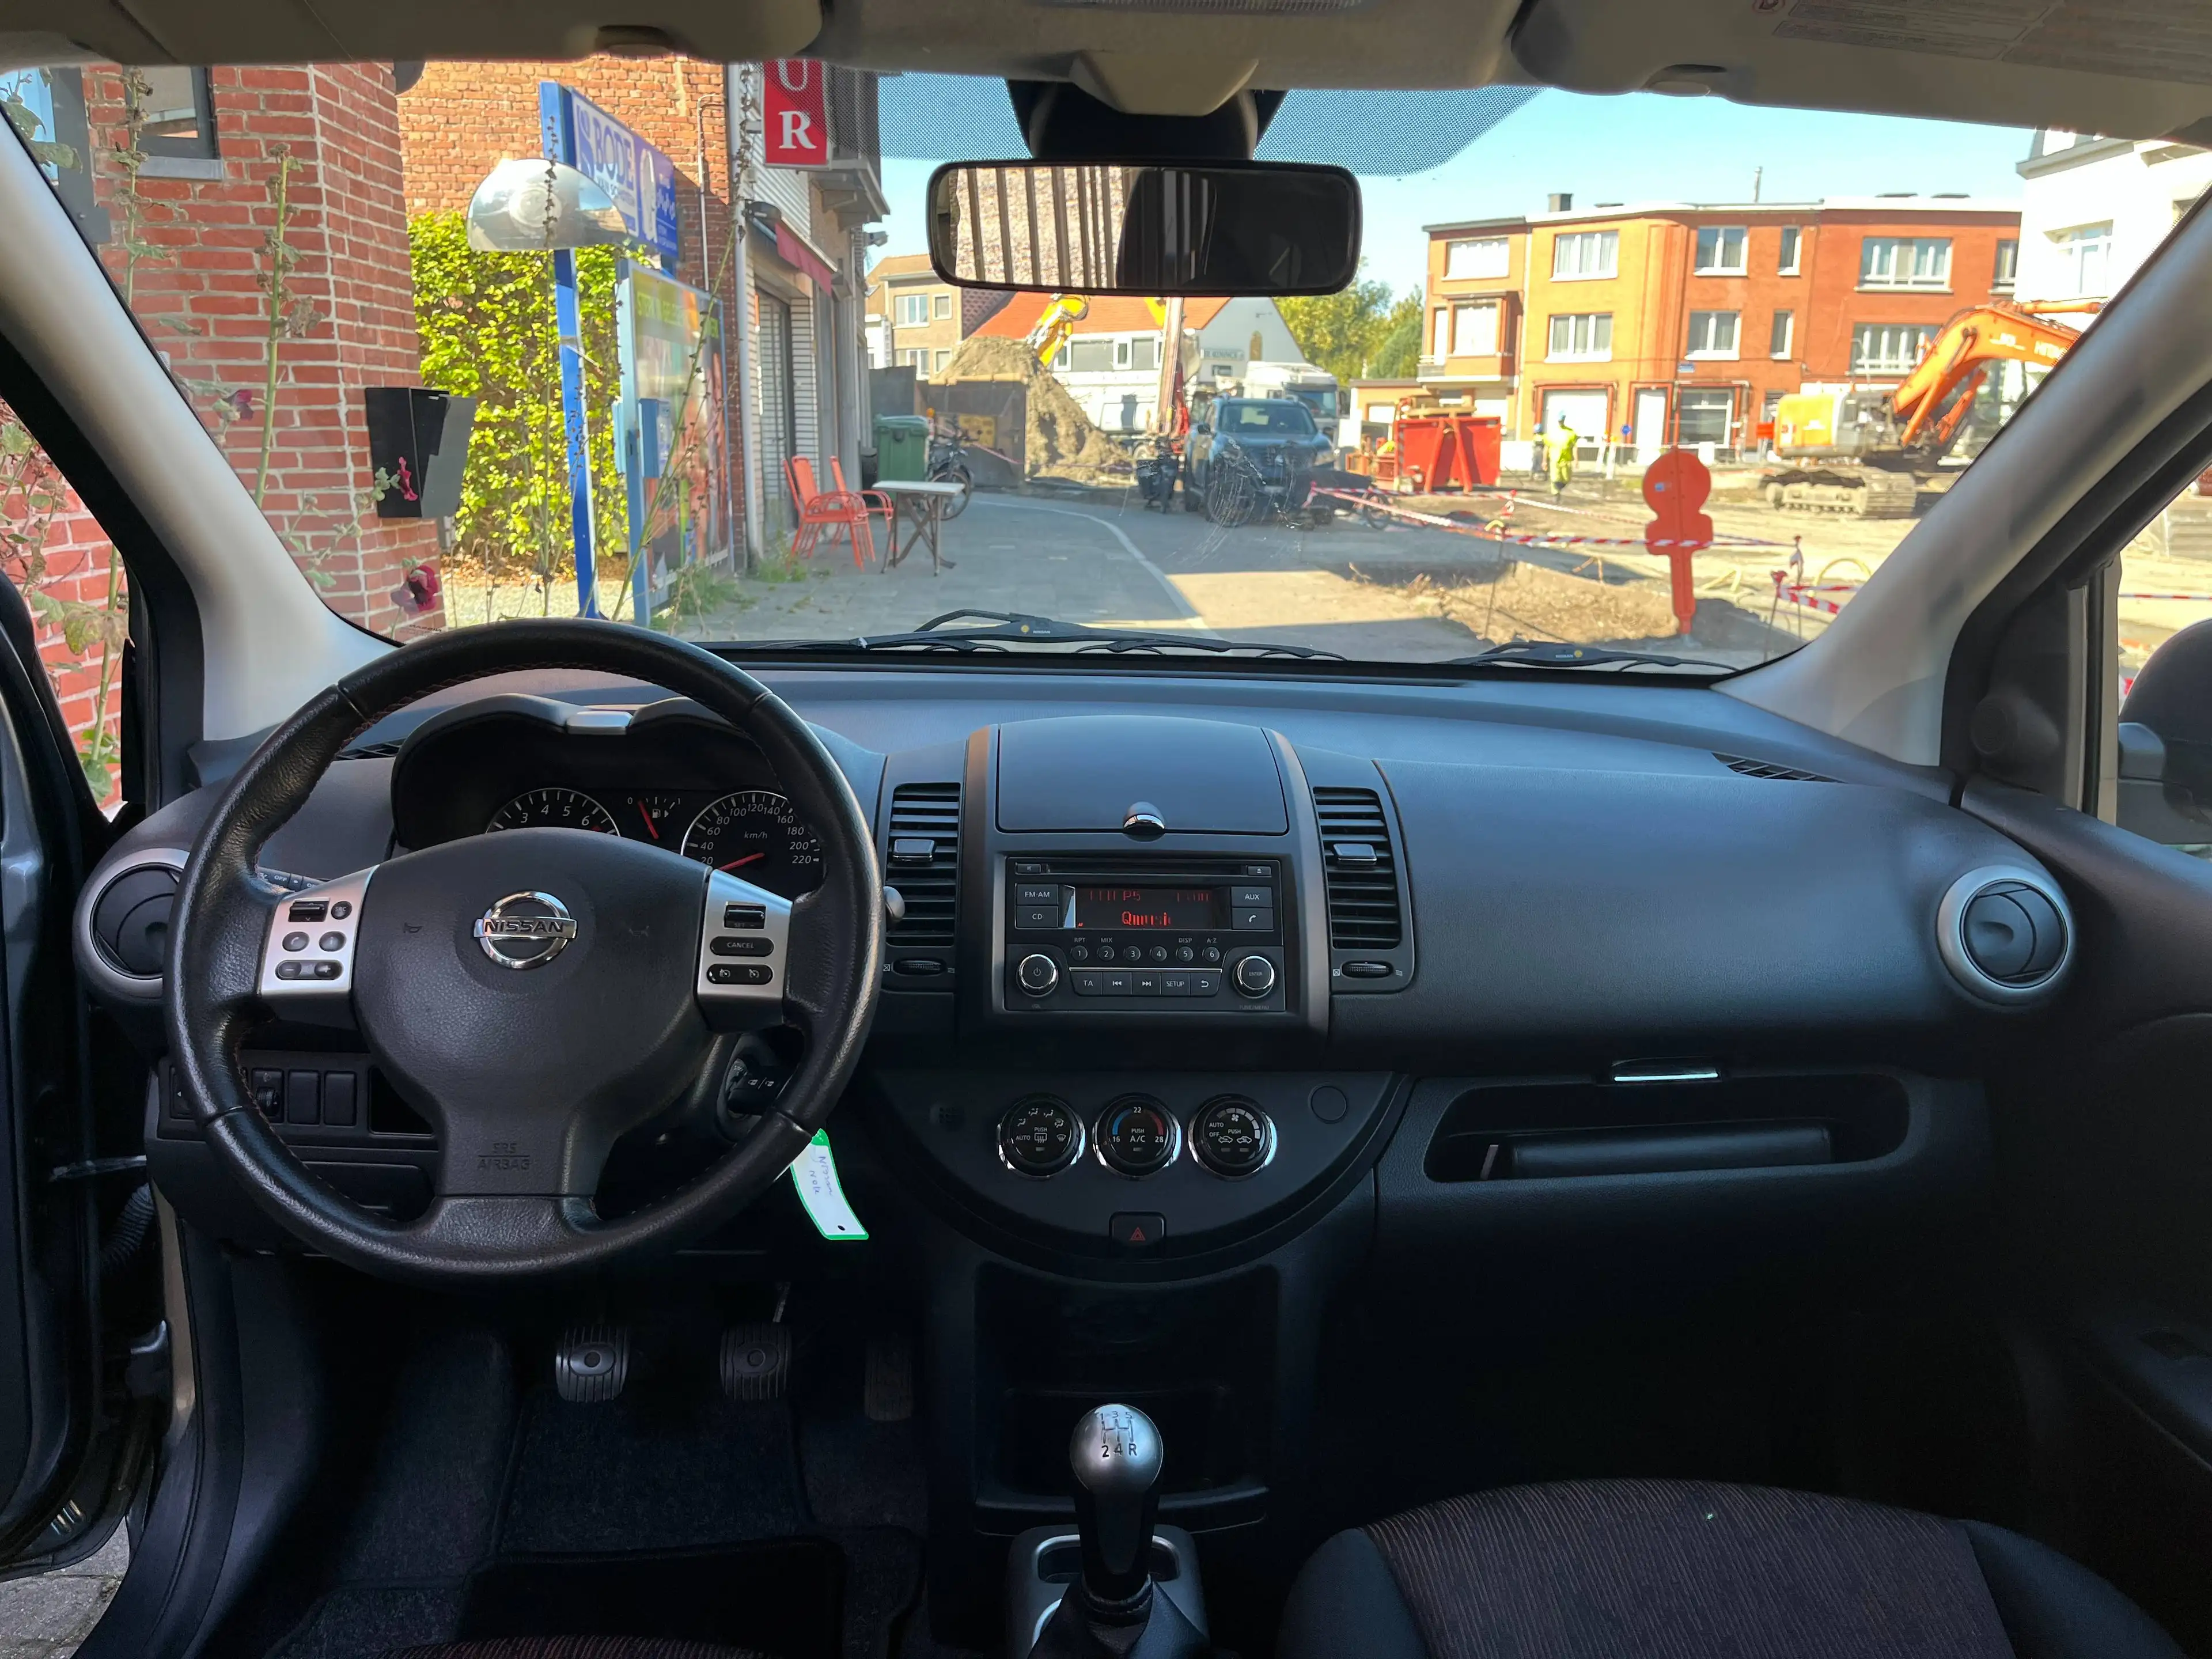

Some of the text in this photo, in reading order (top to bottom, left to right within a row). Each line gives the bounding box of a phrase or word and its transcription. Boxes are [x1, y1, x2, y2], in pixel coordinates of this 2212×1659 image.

[541, 804, 549, 815] 4
[562, 806, 571, 817] 5
[730, 808, 747, 817] 100
[748, 804, 764, 812] 120
[763, 807, 781, 816] 140
[521, 813, 528, 823] 3
[581, 815, 590, 826] 6
[716, 816, 730, 825] 80
[777, 815, 794, 824] 160
[707, 827, 721, 835] 60
[744, 831, 768, 839] km/h
[787, 827, 804, 835] 180
[700, 842, 714, 850] 40
[789, 842, 809, 850] 200
[792, 855, 812, 864] 220
[484, 920, 564, 933] NISSAN
[1101, 1445, 1109, 1457] 2
[1113, 1443, 1123, 1456] 4
[1128, 1442, 1138, 1456] R
